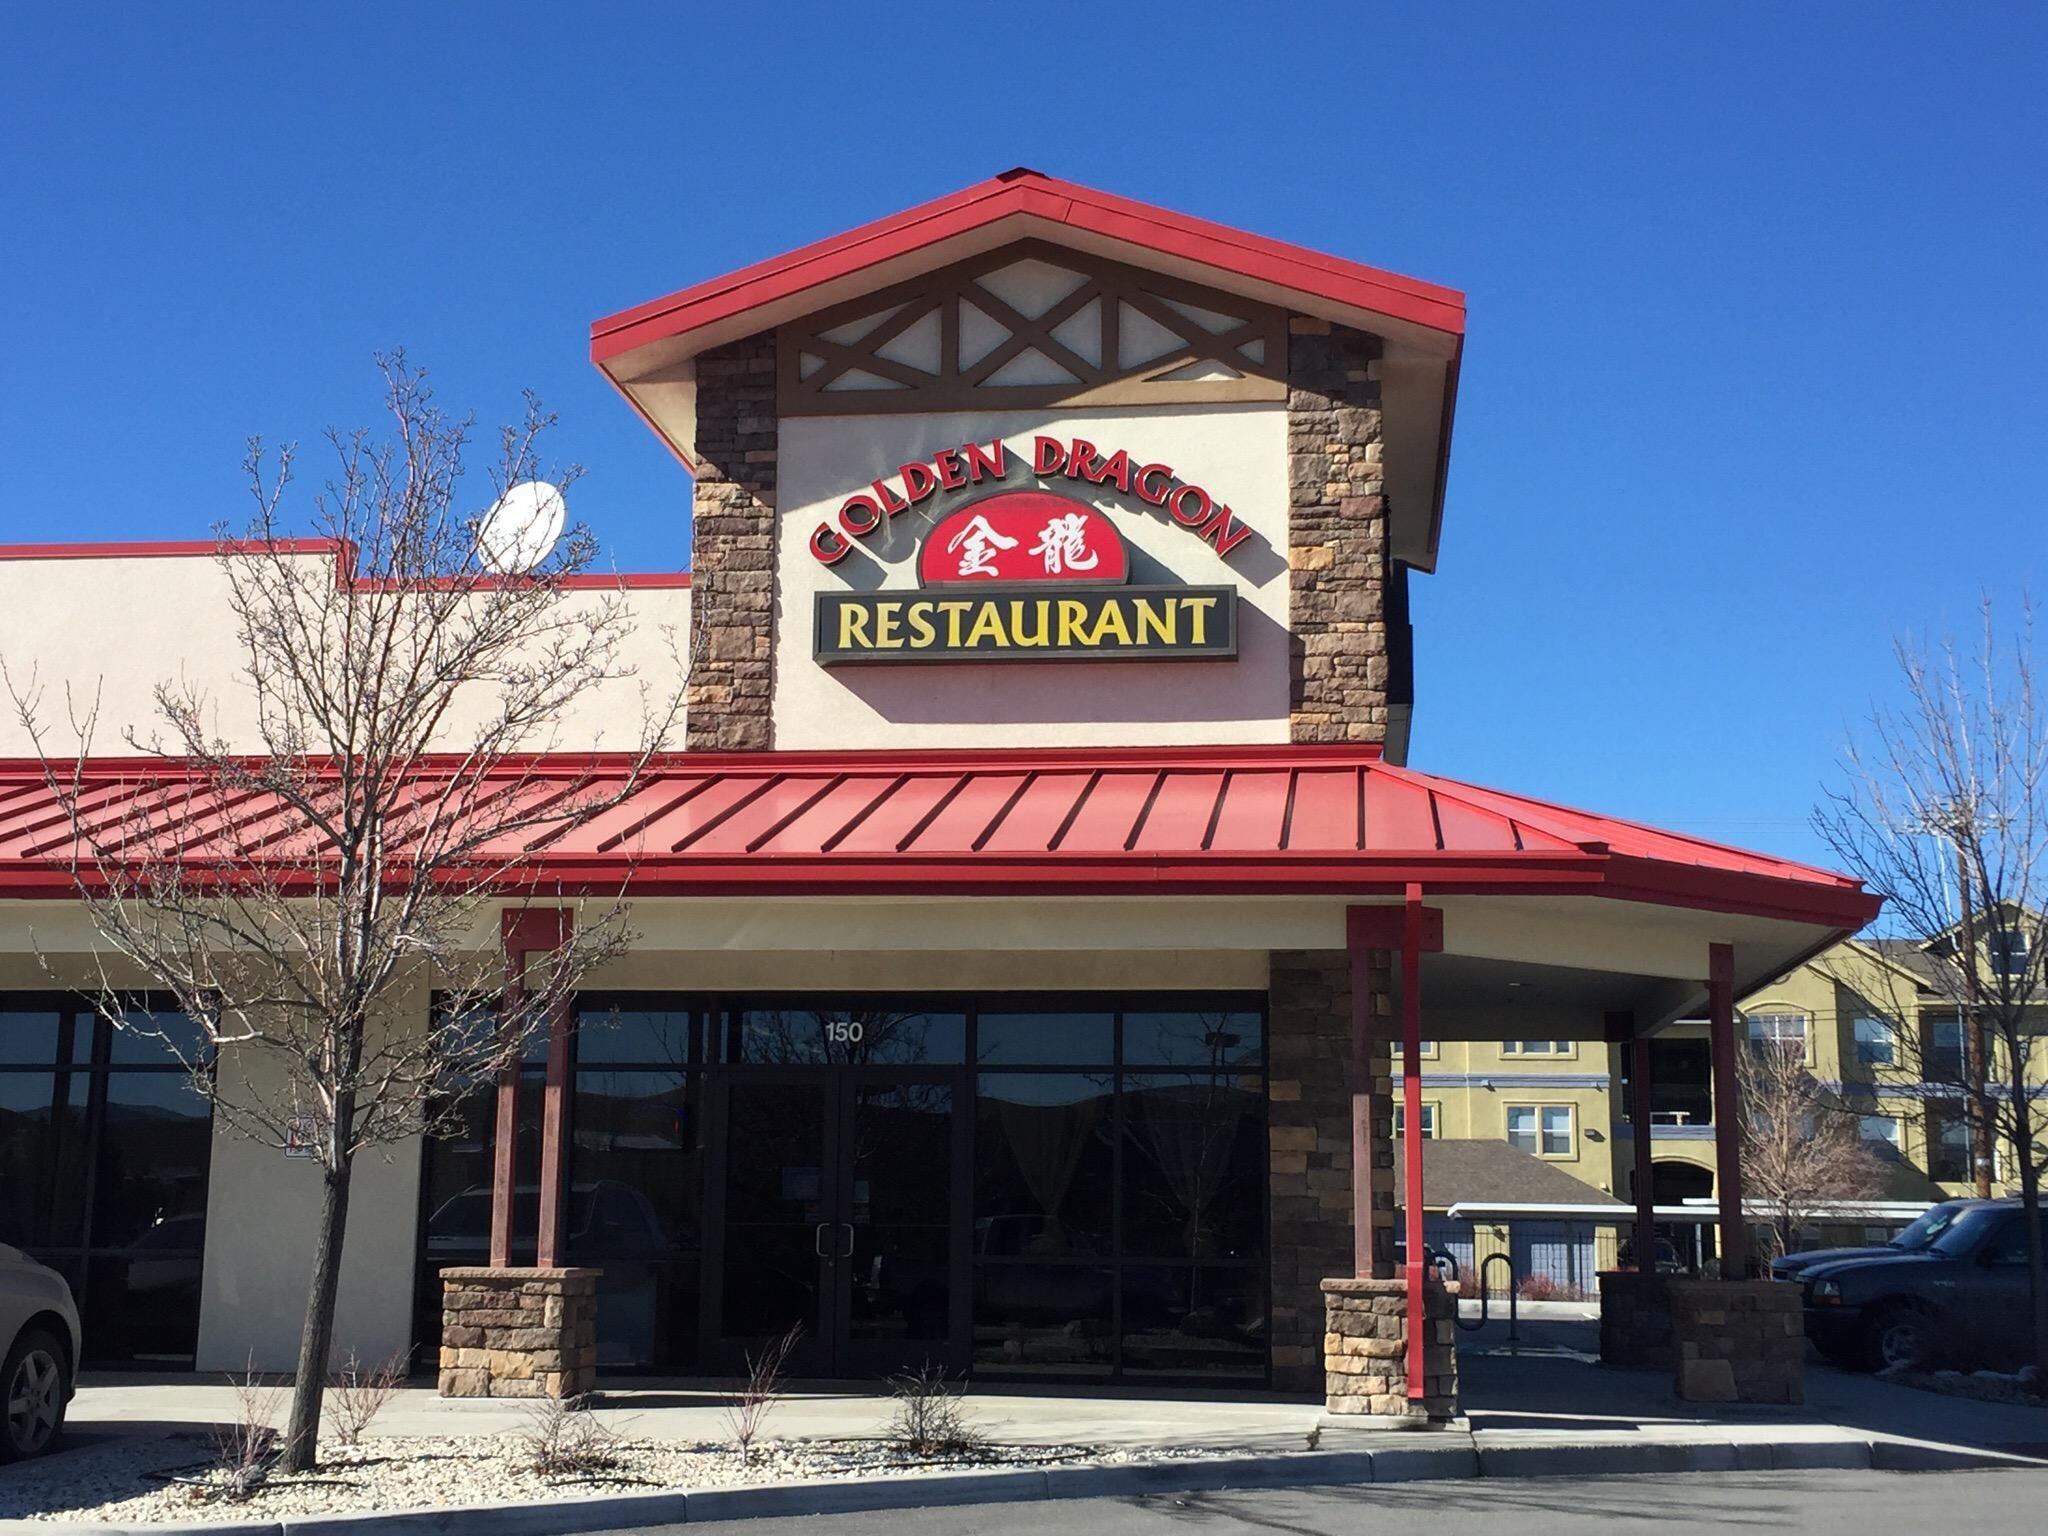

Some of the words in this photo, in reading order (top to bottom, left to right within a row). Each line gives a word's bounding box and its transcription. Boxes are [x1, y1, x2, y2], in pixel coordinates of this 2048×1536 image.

[808, 438, 1006, 566] GOLDEN
[1033, 435, 1252, 558] DRAGON
[947, 512, 1099, 577] 金龍
[837, 597, 1218, 649] RESTAURANT
[825, 1022, 863, 1042] 150
